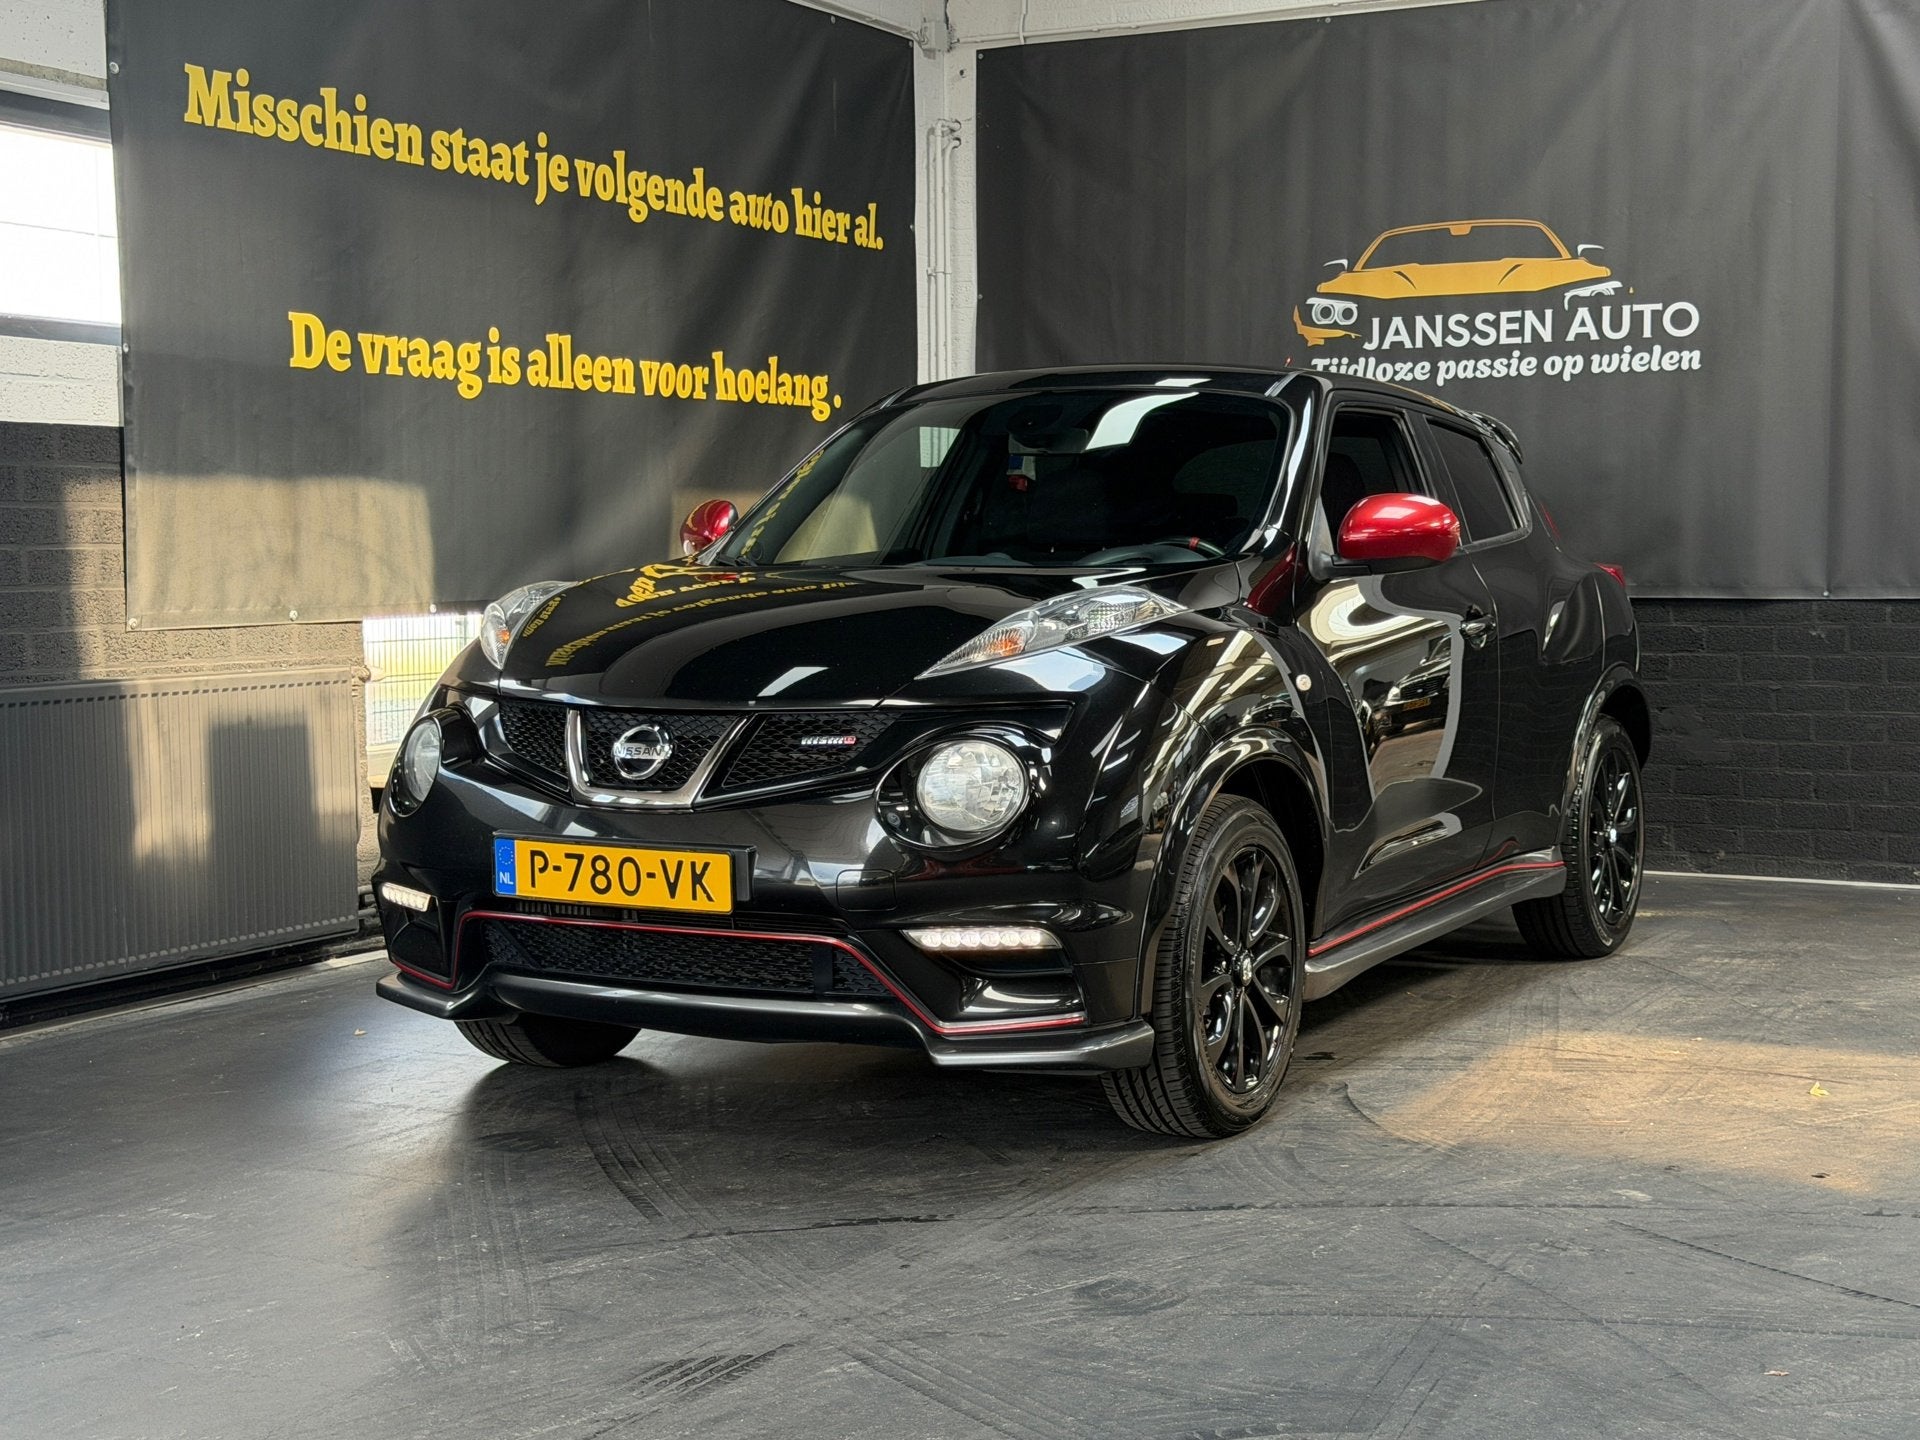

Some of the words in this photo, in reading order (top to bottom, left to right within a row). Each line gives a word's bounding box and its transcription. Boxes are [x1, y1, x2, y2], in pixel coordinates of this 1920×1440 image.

[185, 63, 424, 167] Misschien
[430, 129, 530, 186] staat
[535, 132, 570, 206] je
[575, 150, 725, 224] volgende
[729, 191, 790, 234] auto
[792, 187, 851, 244] hier
[854, 203, 885, 250] al.
[1362, 309, 1554, 351] JANSSEN
[1565, 301, 1700, 342] AUTO
[288, 310, 352, 373] De
[357, 332, 484, 400] vraag
[487, 327, 522, 386] is
[527, 333, 637, 395] alleen
[638, 359, 710, 400] voor
[712, 350, 842, 422] hoelang.
[1436, 350, 1538, 387] passie
[1543, 354, 1584, 382] op
[1590, 344, 1702, 374] wielen
[614, 746, 663, 757] NISSAN
[499, 871, 514, 885] NL
[530, 849, 714, 902] P-780-VK
